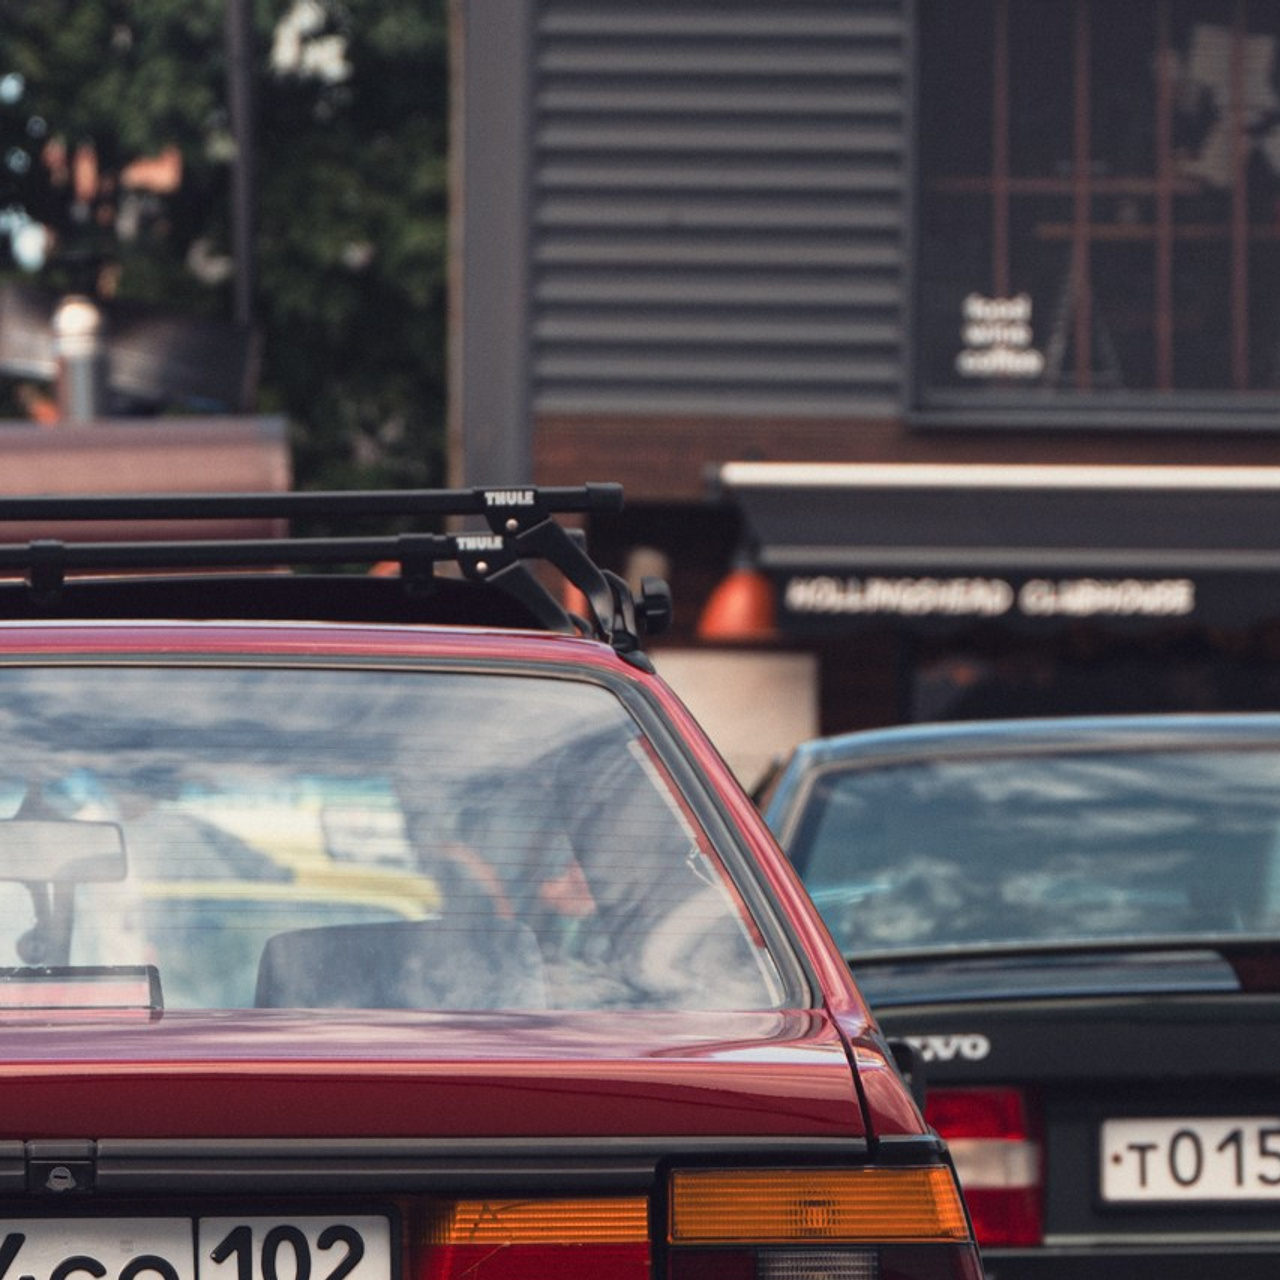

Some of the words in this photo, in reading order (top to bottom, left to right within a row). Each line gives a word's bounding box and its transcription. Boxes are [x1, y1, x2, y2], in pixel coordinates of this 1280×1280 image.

[955, 346, 1045, 378] coffee
[484, 490, 535, 506] THULE
[456, 535, 503, 551] THULE
[1019, 577, 1196, 617] CLUBHOUSE
